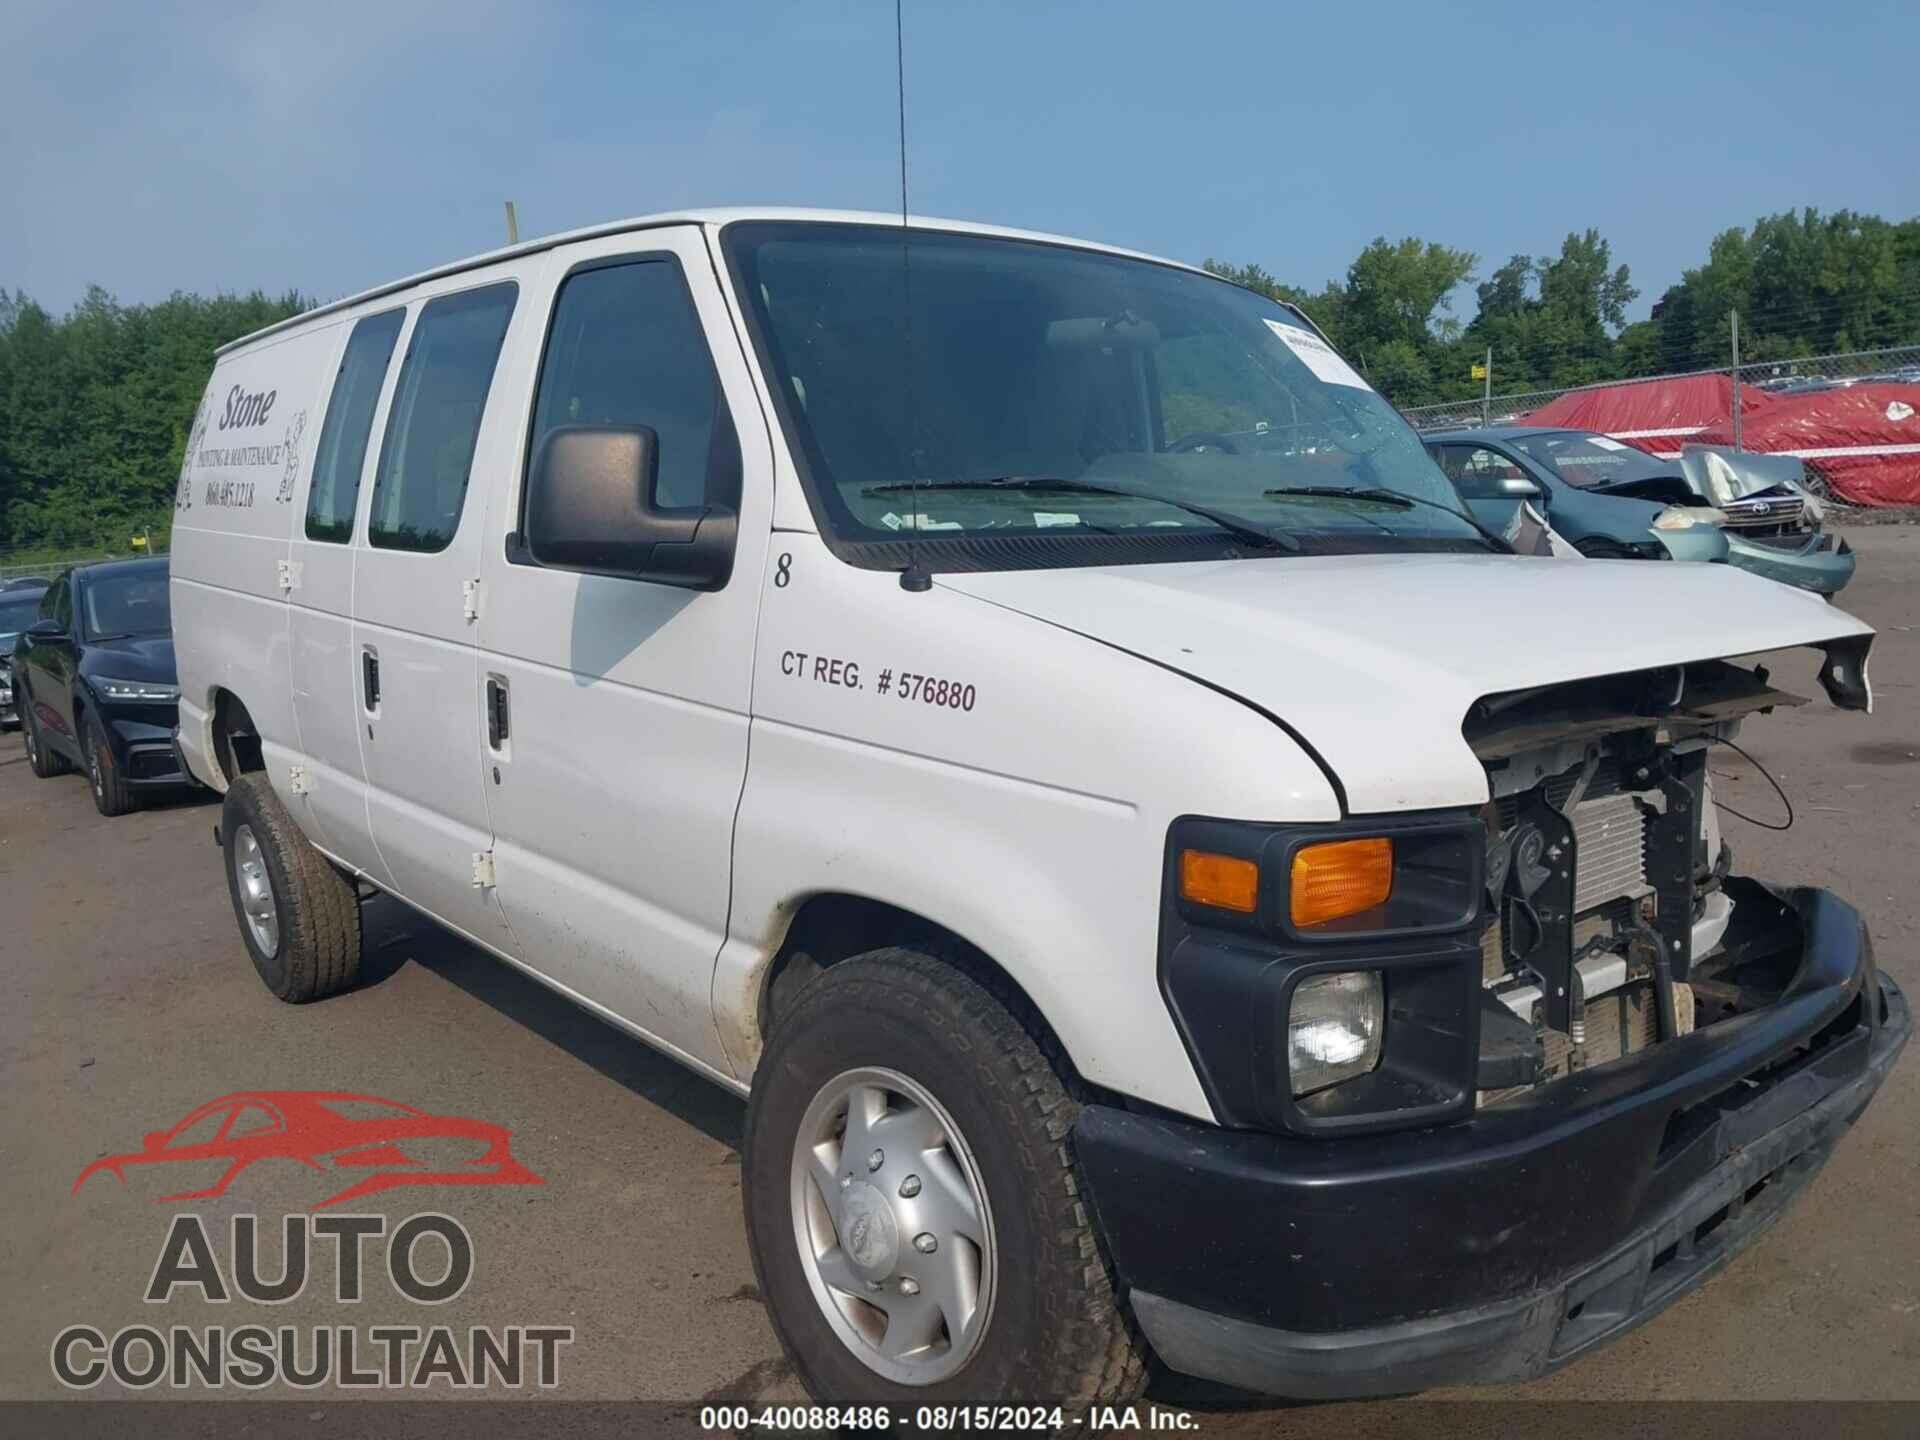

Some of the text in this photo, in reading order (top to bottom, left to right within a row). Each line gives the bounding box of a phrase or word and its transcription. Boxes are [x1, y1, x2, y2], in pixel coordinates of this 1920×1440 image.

[219, 384, 277, 431] Stone
[231, 445, 281, 466] MAINTENANCE
[775, 553, 792, 587] 8
[781, 651, 976, 712] CT REG. # 576880
